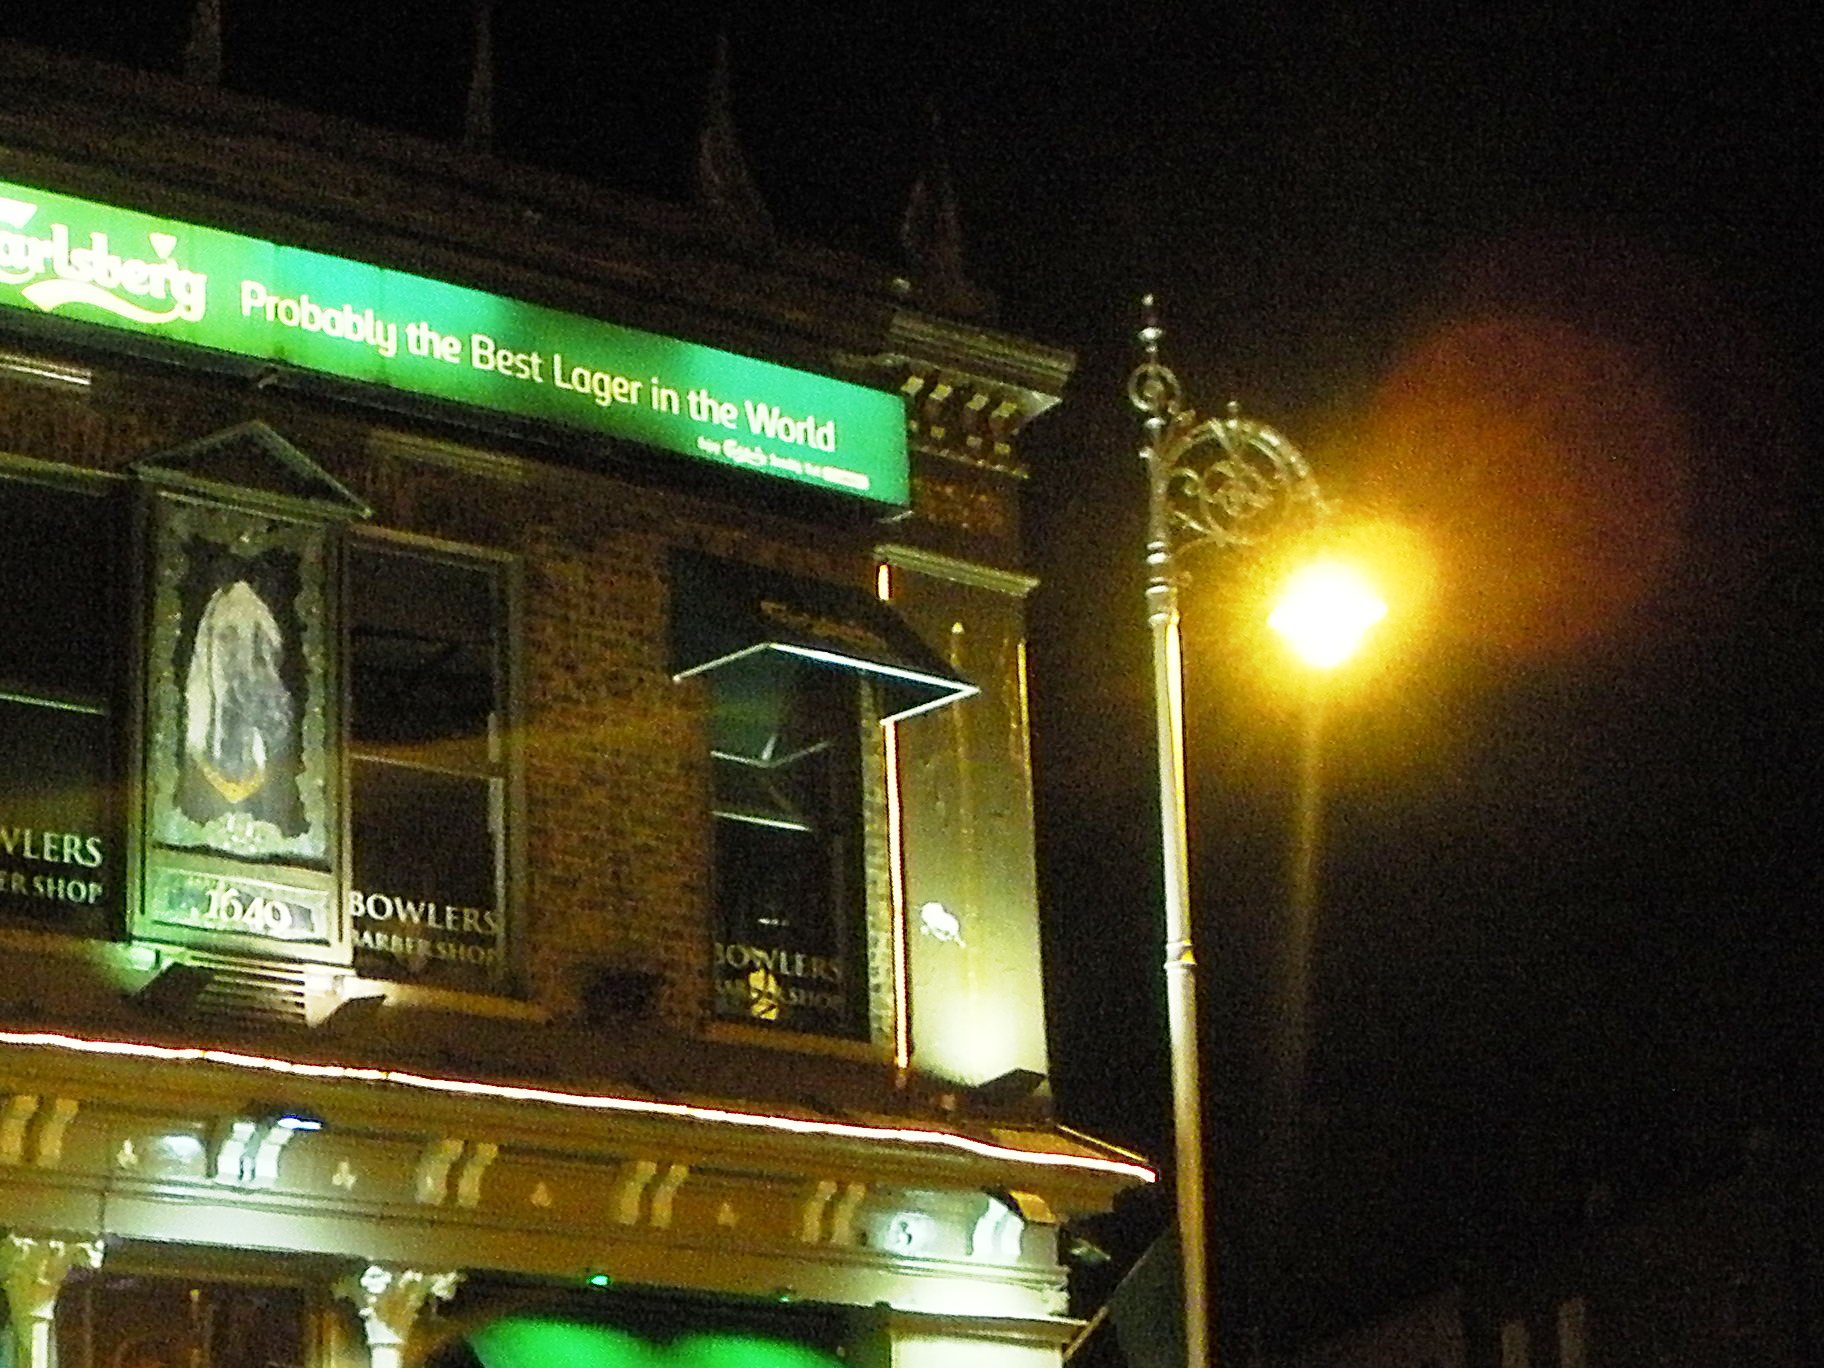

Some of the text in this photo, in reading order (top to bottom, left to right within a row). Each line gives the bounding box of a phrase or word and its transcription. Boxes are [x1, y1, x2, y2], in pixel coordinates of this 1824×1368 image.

[239, 279, 836, 453] Probably the Best Lager in the World
[32, 876, 103, 905] SHOP
[349, 889, 501, 936] BOWLERS
